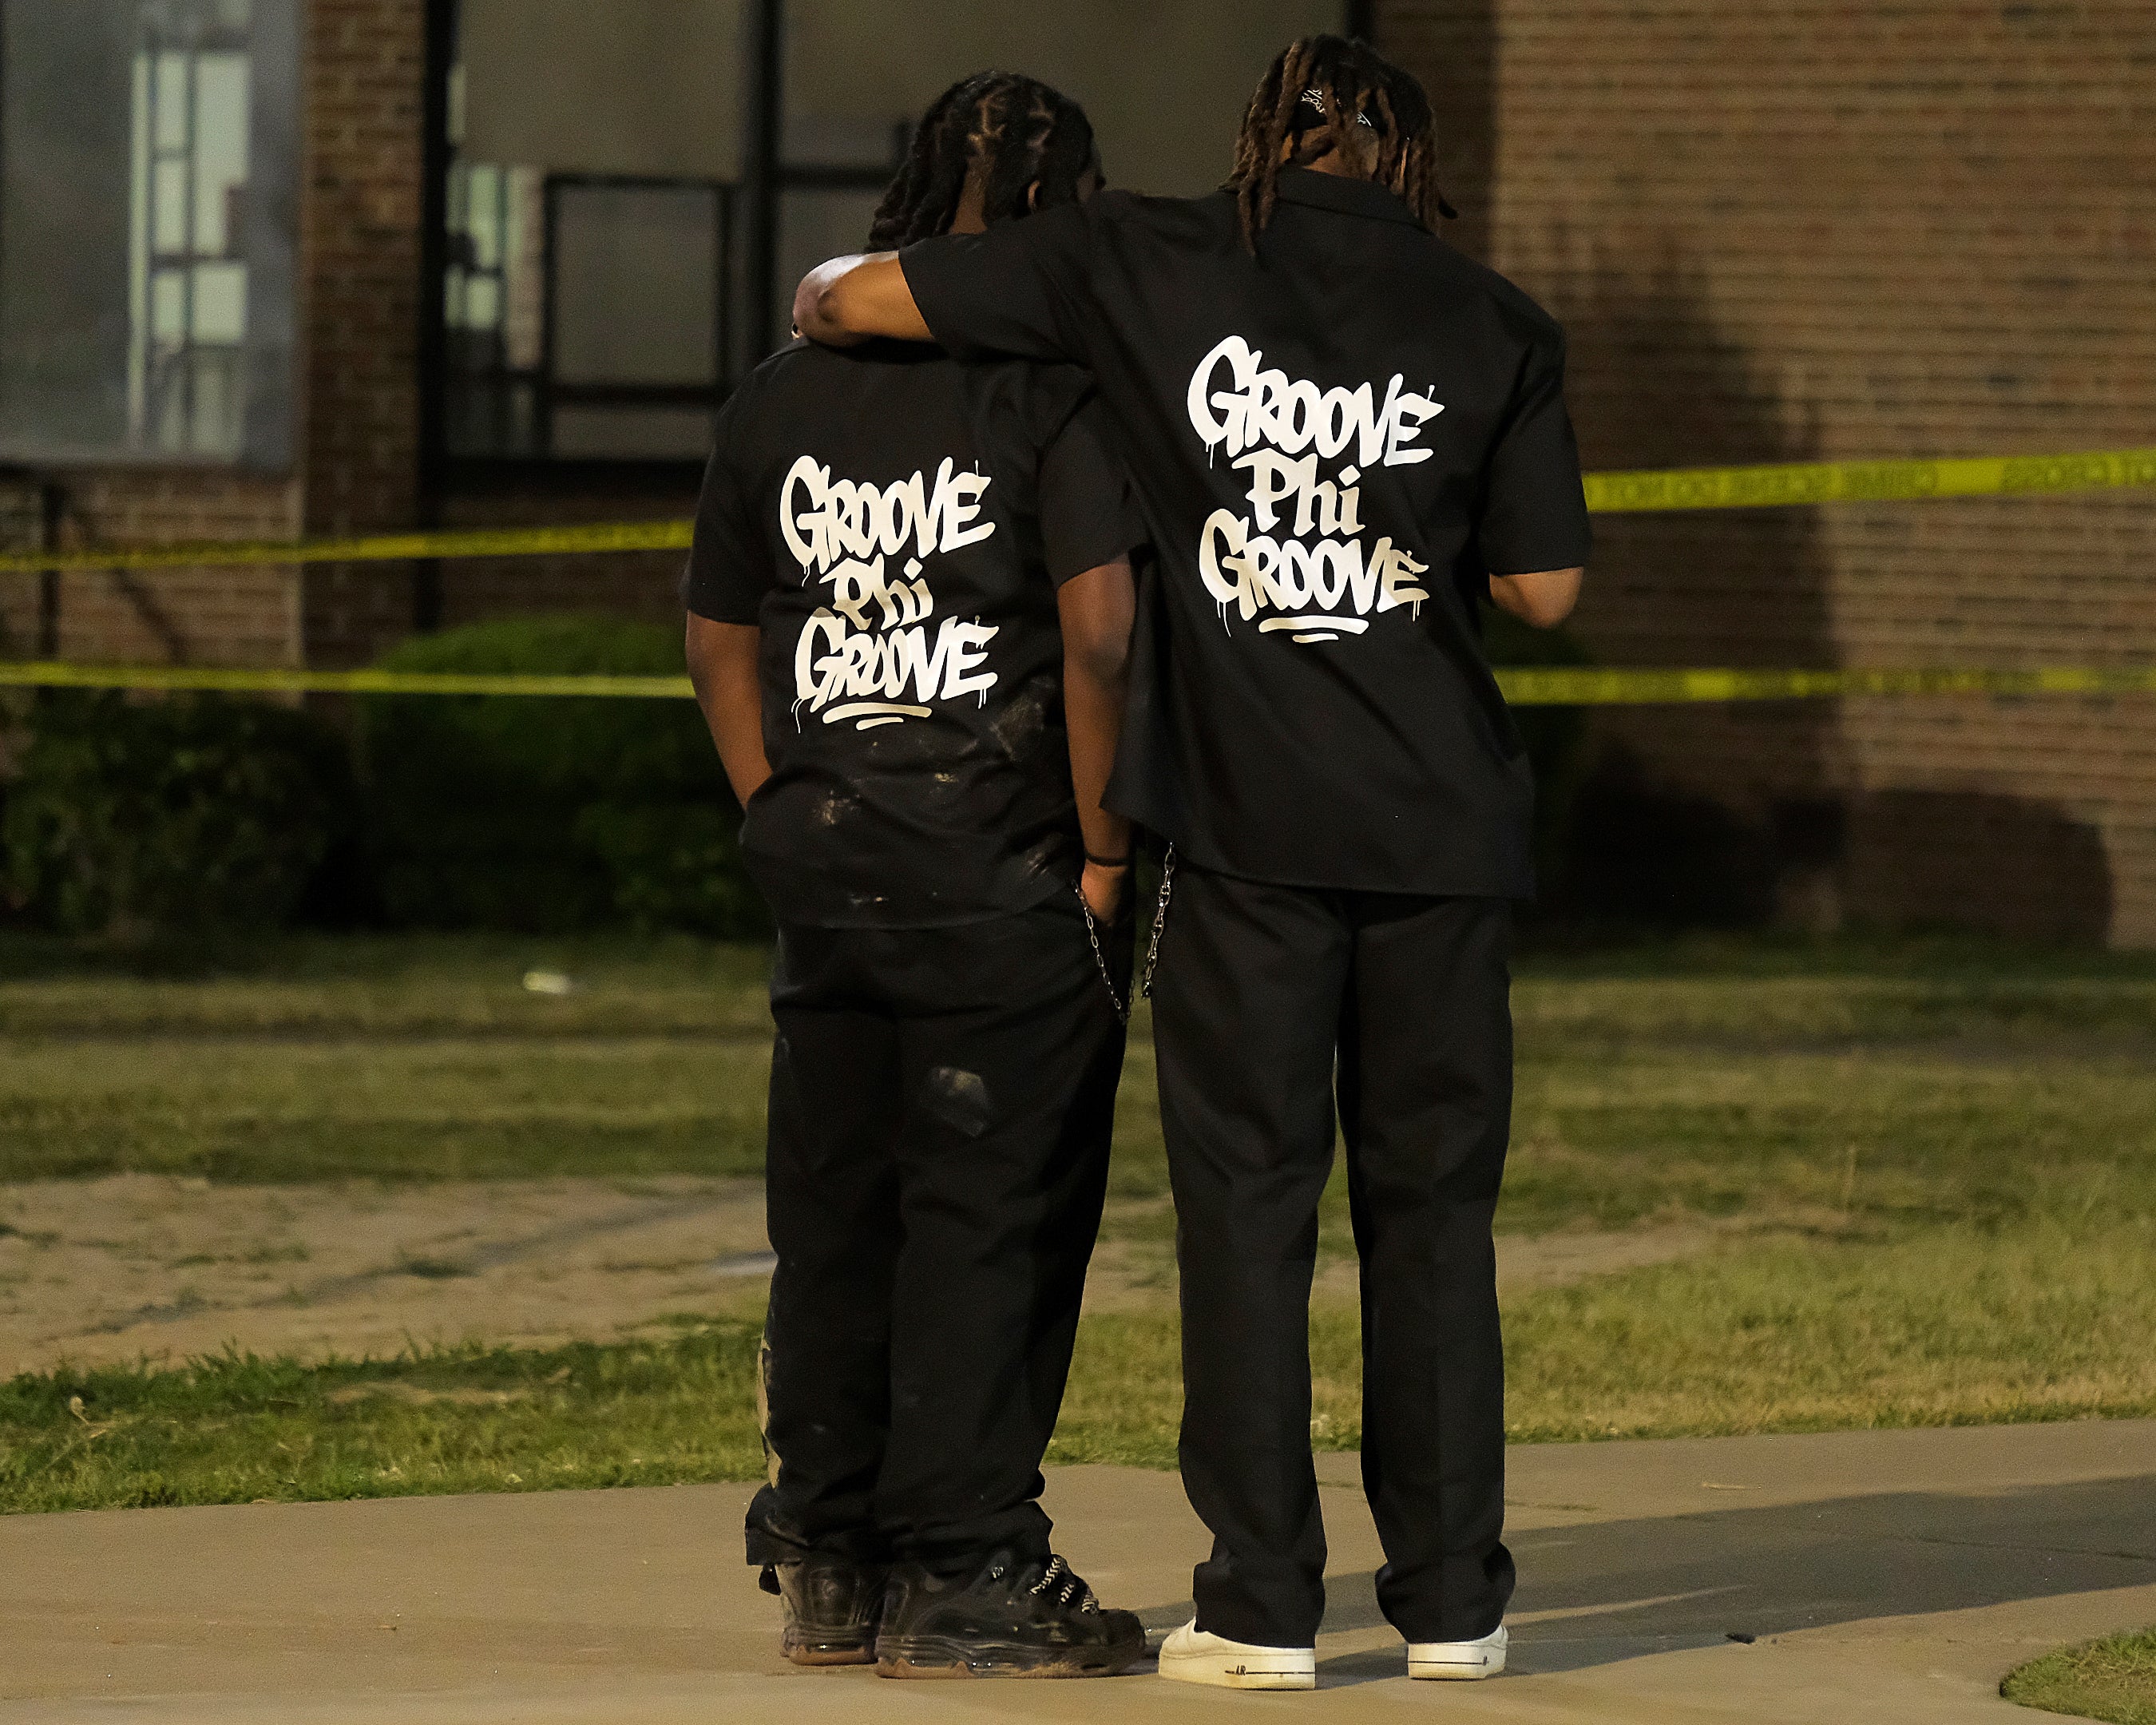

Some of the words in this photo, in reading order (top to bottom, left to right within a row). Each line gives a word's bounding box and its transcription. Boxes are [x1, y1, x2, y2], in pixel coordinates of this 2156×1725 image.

[1187, 335, 1445, 468] GROOVE
[780, 454, 996, 575] GROOVE
[1231, 447, 1365, 537] Phi
[818, 553, 933, 631] Phi
[1199, 508, 1430, 621] GROOVE
[795, 606, 1000, 713] GROOVE
